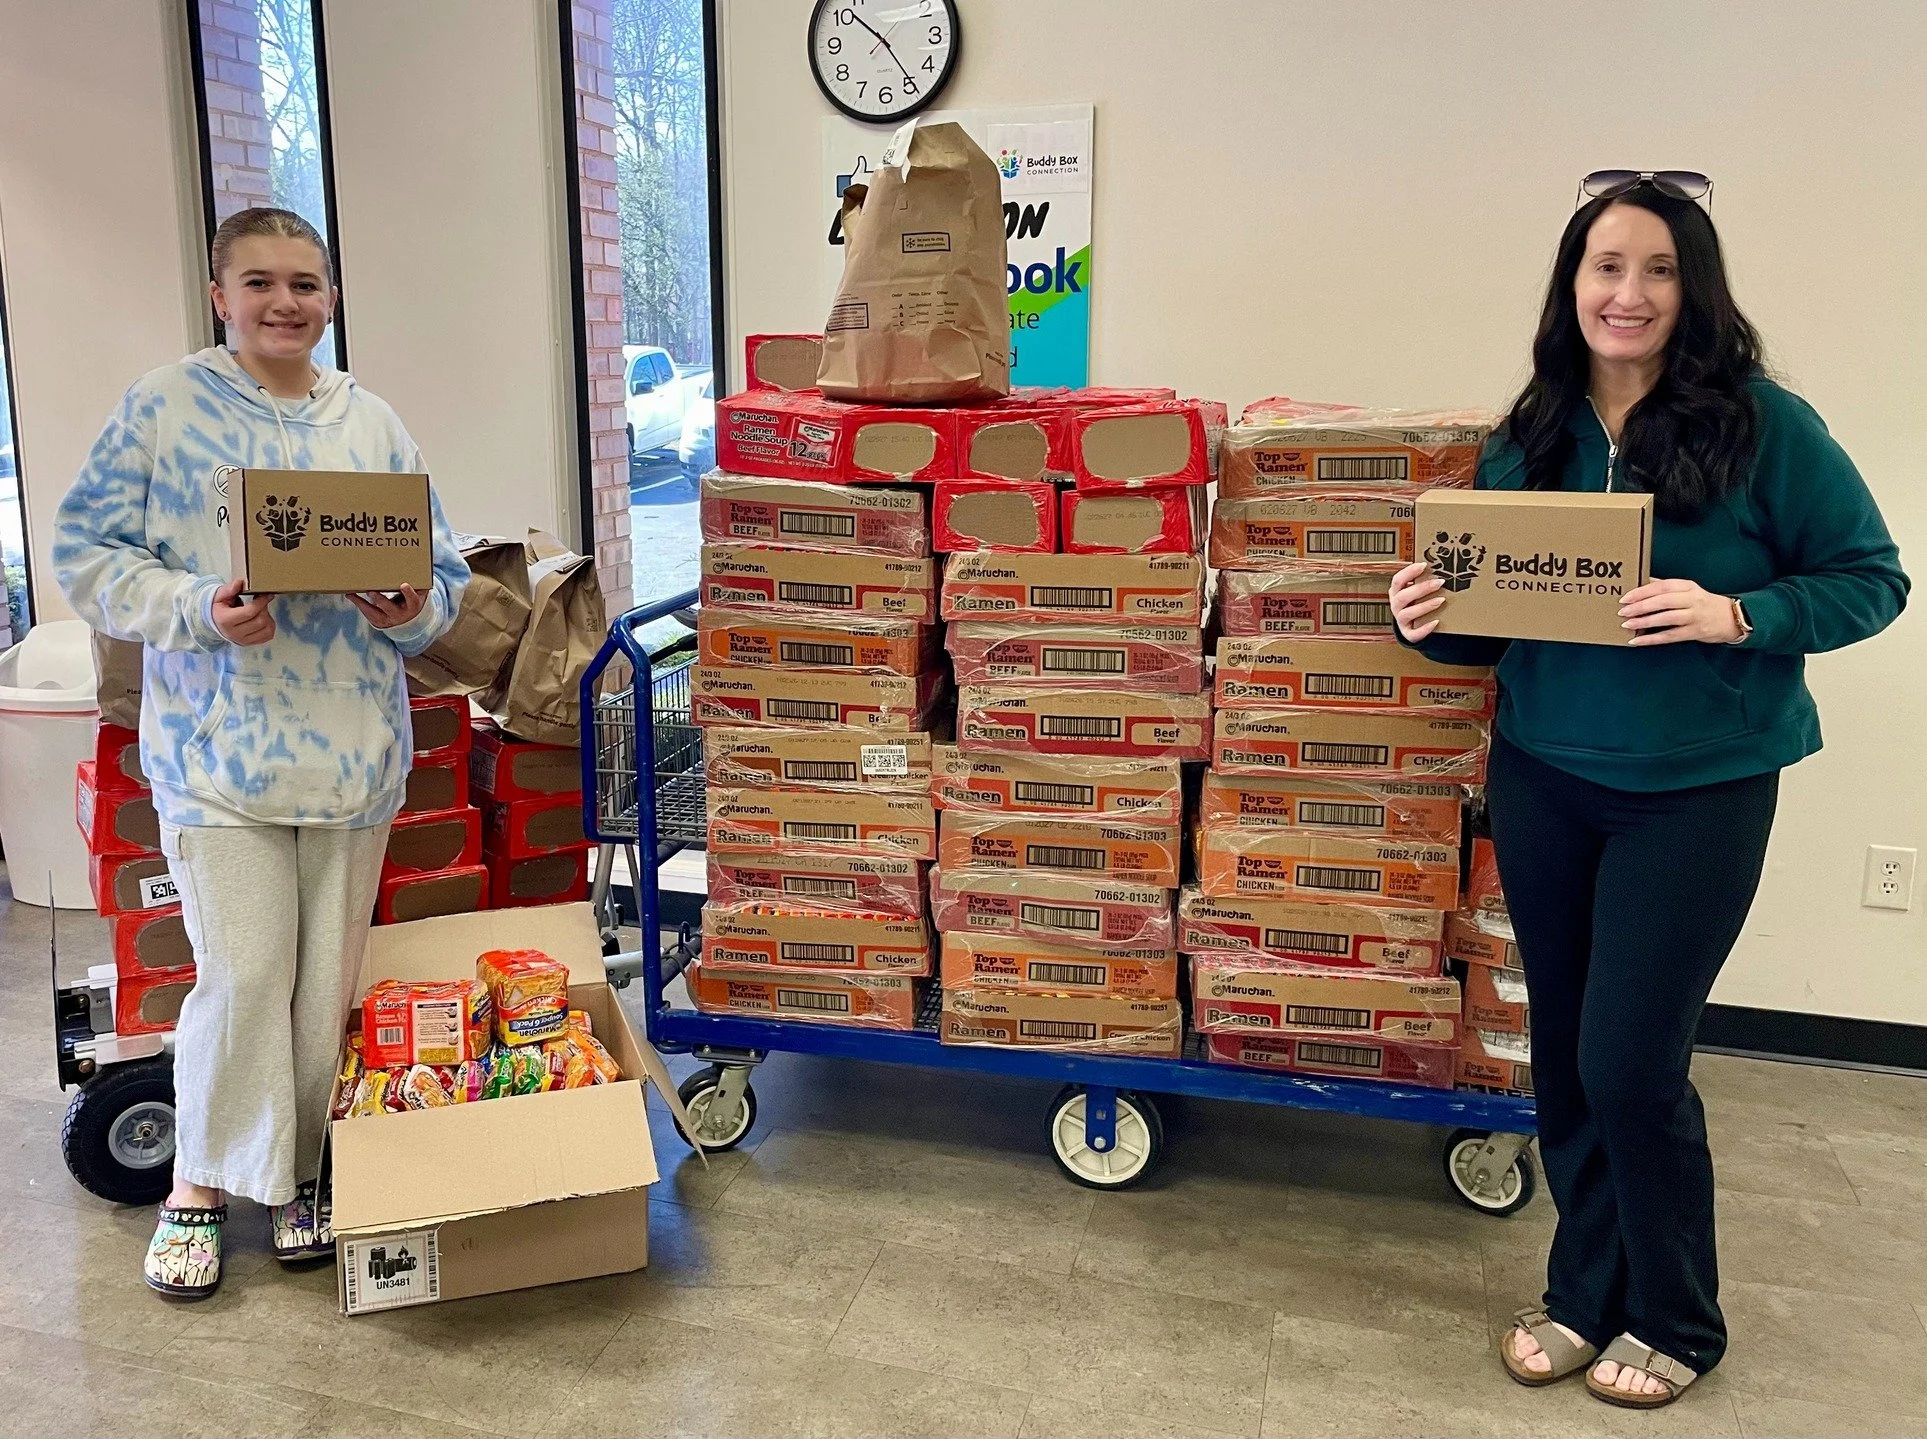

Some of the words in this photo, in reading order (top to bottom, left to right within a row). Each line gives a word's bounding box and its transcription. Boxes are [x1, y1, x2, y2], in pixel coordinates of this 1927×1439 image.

[833, 8, 854, 26] 10
[928, 26, 942, 44] 3
[828, 37, 842, 55] 9
[921, 55, 935, 73] 4
[836, 64, 849, 81] 8
[856, 81, 867, 98] 7
[903, 76, 917, 95] 5
[879, 87, 893, 104] 6
[1027, 156, 1057, 169] Buddy
[1060, 155, 1078, 166] Box
[1027, 166, 1079, 175] CONNECTION
[744, 424, 776, 435] Ramen
[731, 431, 764, 442] Noodle
[764, 435, 789, 446] Soup
[756, 446, 780, 456] Flavor
[790, 442, 807, 457] 12
[1255, 452, 1280, 463] Top
[1256, 461, 1306, 473] Ramen
[1256, 476, 1296, 486] CHICKEN
[850, 496, 912, 508] 70662-01302
[730, 503, 752, 514] Top
[320, 512, 377, 533] Buddy
[384, 515, 418, 532] Box
[730, 513, 772, 525] Ramen
[733, 525, 758, 535] BEEF
[1247, 524, 1271, 535] Top
[321, 537, 420, 547] CONNECTION
[1247, 534, 1297, 546] Ramen
[1247, 548, 1285, 559] CHICKEN
[1149, 562, 1190, 571] 41789-90211
[1496, 552, 1568, 577] Buddy
[1576, 558, 1623, 578] Box
[1495, 579, 1623, 596] CONNECTION
[711, 586, 767, 602] Ramen
[882, 597, 906, 608] Beef
[955, 595, 1015, 611] Ramen
[1136, 598, 1183, 610] Chicken
[1261, 597, 1287, 608] Top
[1261, 607, 1313, 619] Ramen
[1265, 620, 1295, 631] BEEF
[728, 632, 751, 643] Top
[730, 643, 772, 654] Ramen
[730, 654, 763, 664] CHICKEN
[986, 653, 1034, 664] Ramen
[1224, 681, 1289, 698] Ramen
[1419, 688, 1471, 699] Chicken
[701, 703, 755, 720] Ramen
[967, 724, 1026, 740] Ramen
[1153, 727, 1181, 738] Beef
[1222, 749, 1286, 765] Ramen
[1413, 756, 1463, 767] Chicken
[718, 769, 773, 782] Ramen
[943, 786, 1001, 803] Ramen
[1380, 784, 1451, 796] 70662-01303
[1116, 798, 1162, 809] Chicken
[1240, 793, 1265, 804] Top
[1240, 803, 1289, 815] Ramen
[1240, 816, 1278, 826] CHICKEN
[716, 829, 773, 845] Ramen
[878, 834, 919, 846] Chicken
[972, 836, 995, 847] Top
[971, 846, 1017, 858] Ramen
[1376, 849, 1447, 862] 70662-01303
[848, 863, 908, 873] 70662-01302
[971, 858, 1007, 868] CHICKEN
[1238, 856, 1263, 868] Top
[734, 870, 755, 879] Top
[1237, 867, 1286, 879] Ramen
[735, 878, 776, 888] Ramen
[1236, 880, 1274, 891] CHICKEN
[967, 895, 990, 906] Top
[1095, 890, 1160, 904] 70662-01302
[967, 905, 1013, 916] Ramen
[970, 917, 997, 926] BEEF
[1187, 932, 1250, 949] Ramen
[1455, 937, 1477, 949] Top
[714, 948, 769, 964] Ramen
[1382, 948, 1410, 959] Beef
[1455, 946, 1496, 960] Ramen
[875, 954, 917, 965] Chicken
[973, 954, 998, 965] Top
[974, 963, 1018, 974] Ramen
[727, 982, 749, 992] Top
[729, 990, 770, 1000] Ramen
[729, 1000, 762, 1009] CHICKEN
[1472, 1005, 1493, 1017] Top
[541, 1013, 563, 1023] Souper
[1207, 1010, 1271, 1026] Ramen
[1472, 1013, 1512, 1025] Ramen
[519, 1026, 557, 1037] Maruchan
[950, 1024, 1006, 1039] Ramen
[1404, 1021, 1432, 1032] Beef
[1244, 1053, 1271, 1062] BEEF
[1464, 1062, 1484, 1072] Top
[1464, 1070, 1505, 1083] Ramen
[376, 1277, 410, 1290] UN3481
